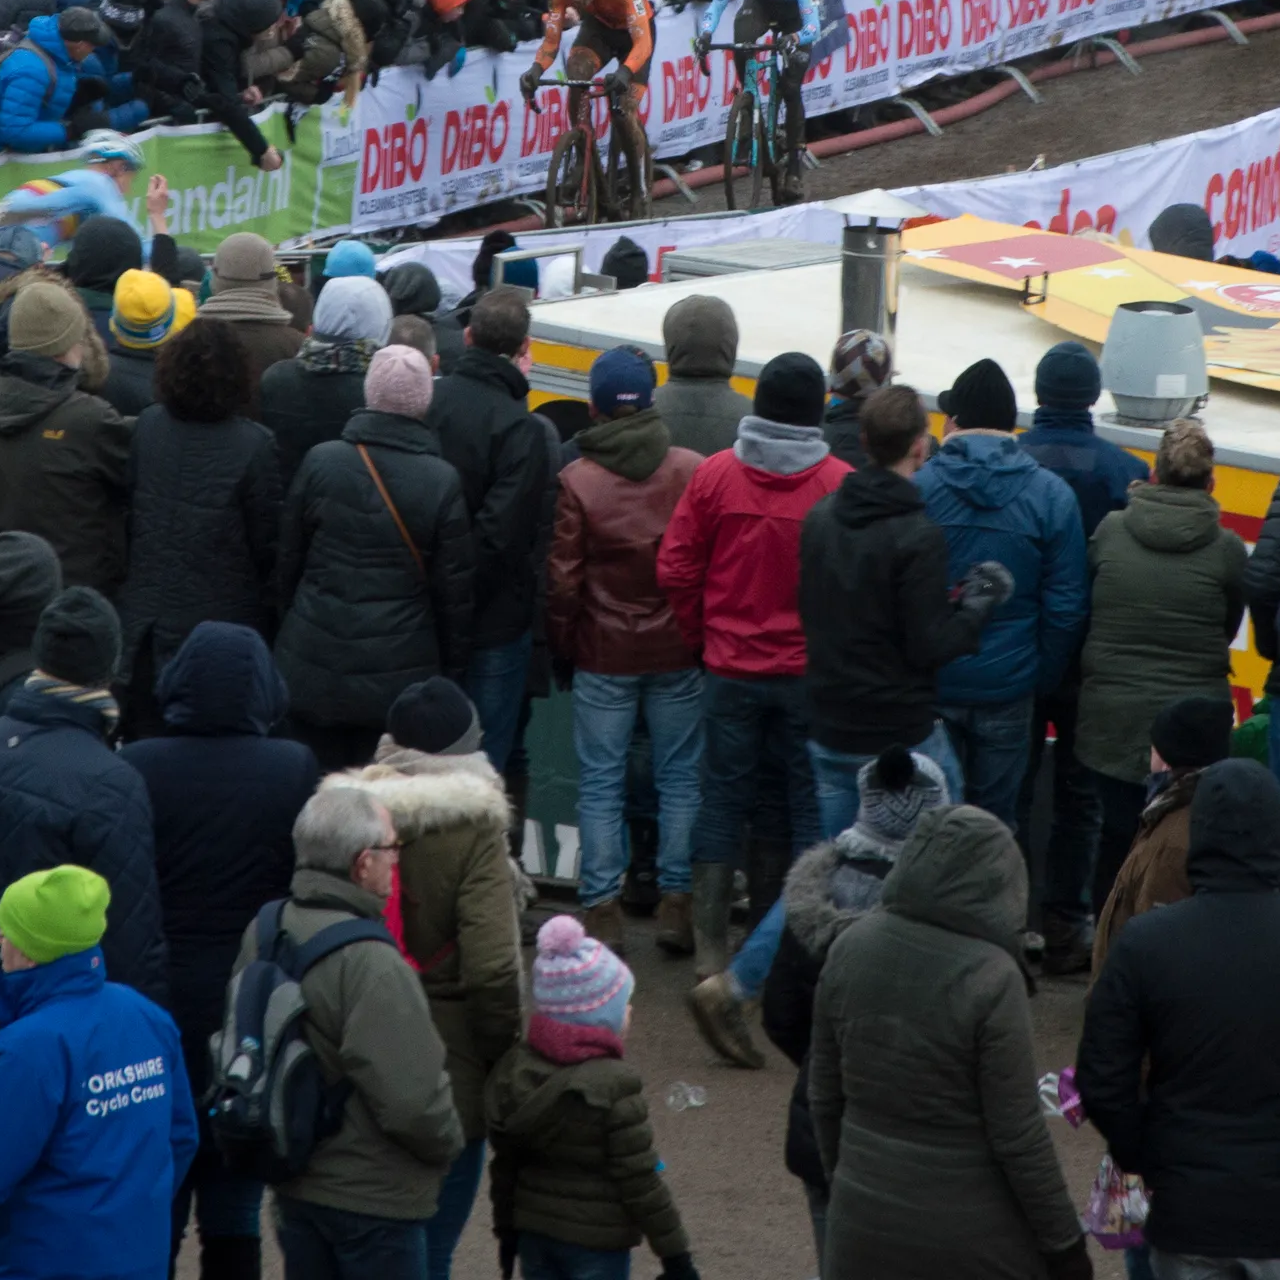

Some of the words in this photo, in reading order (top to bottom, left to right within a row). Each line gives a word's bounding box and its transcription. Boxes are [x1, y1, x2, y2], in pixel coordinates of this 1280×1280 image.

[360, 118, 429, 194] DiBO
[440, 100, 510, 176] DiBO
[520, 87, 572, 158] DiB
[82, 1055, 165, 1095] ORKSHIRE
[85, 1091, 130, 1118] Cyclo
[130, 1082, 166, 1104] Cross
